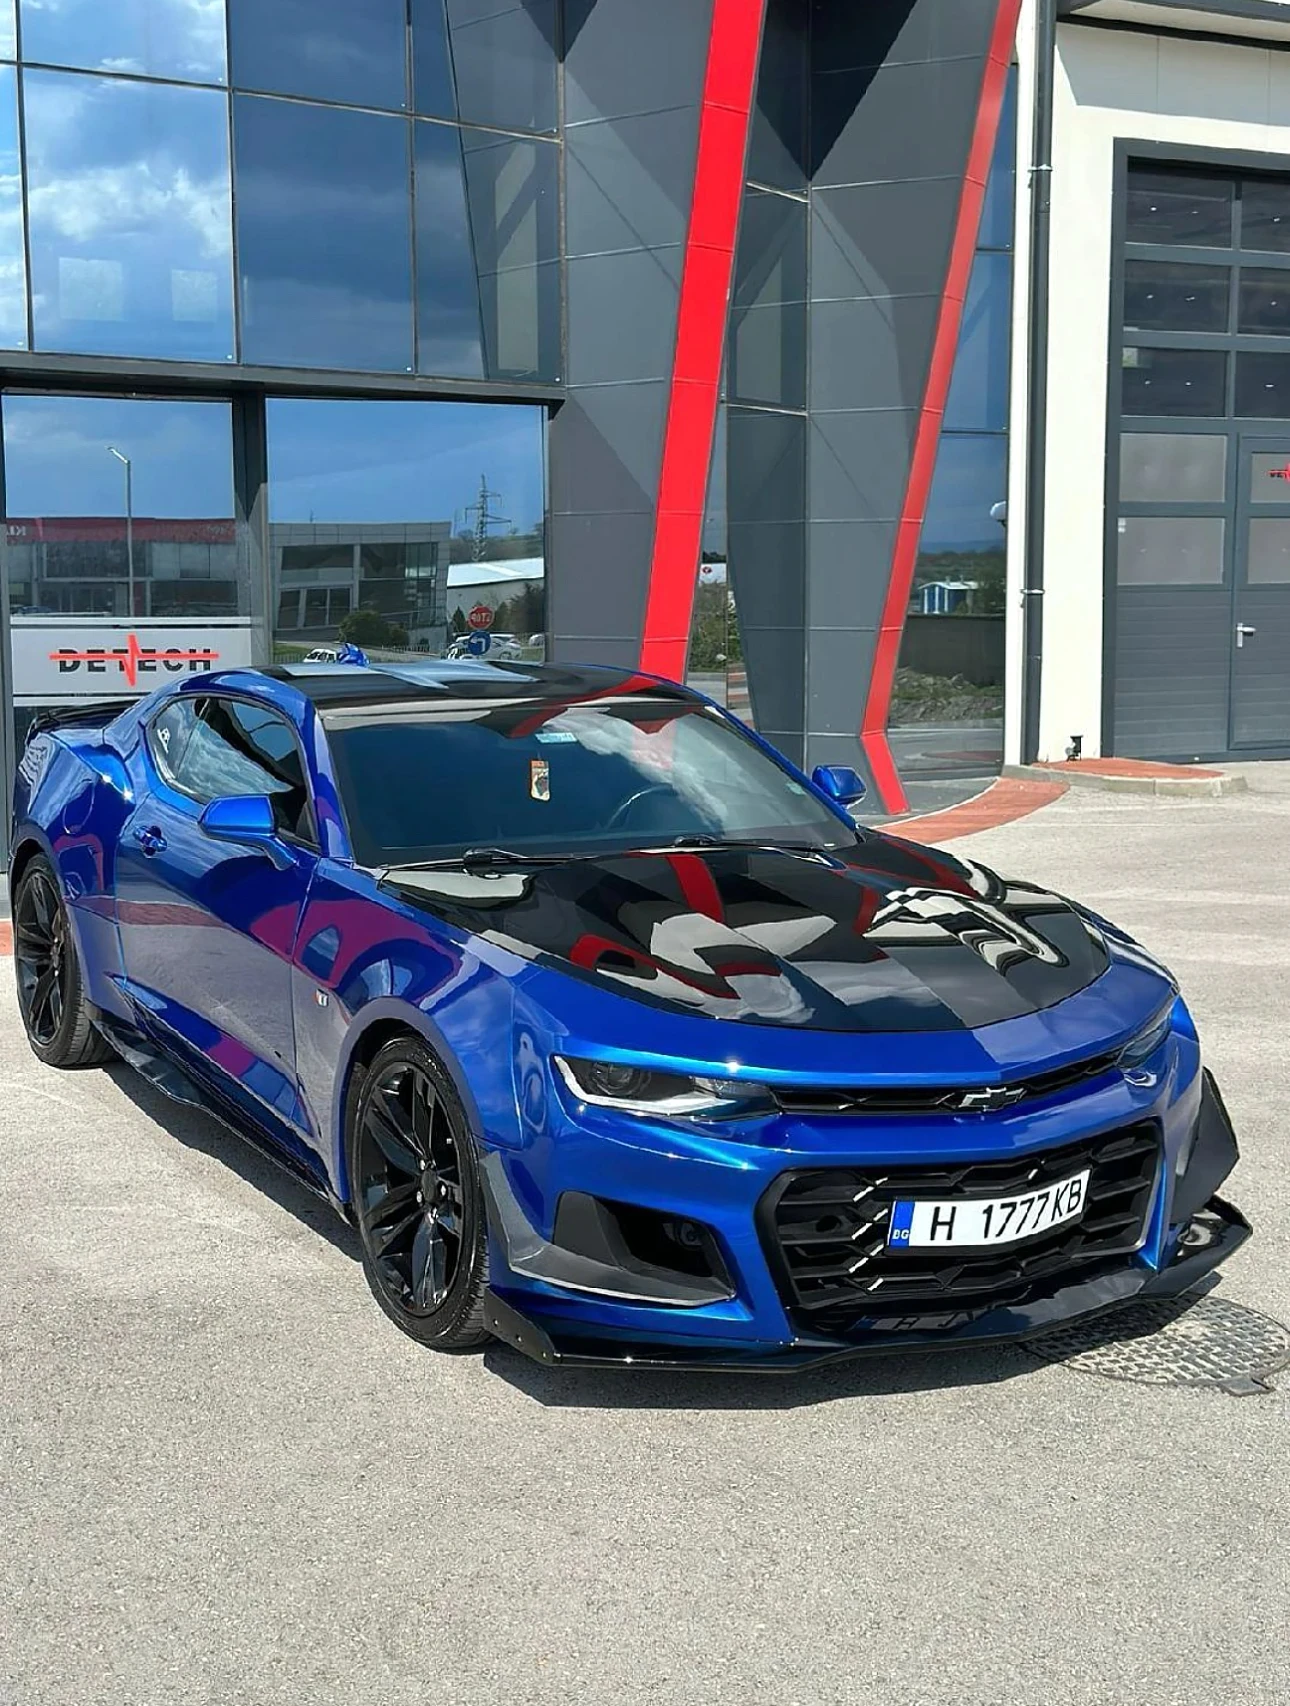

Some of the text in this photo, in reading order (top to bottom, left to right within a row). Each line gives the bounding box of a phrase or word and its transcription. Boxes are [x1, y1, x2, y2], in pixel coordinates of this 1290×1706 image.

[59, 648, 211, 672] DETECH
[892, 1230, 910, 1240] BG
[930, 1206, 956, 1241] H
